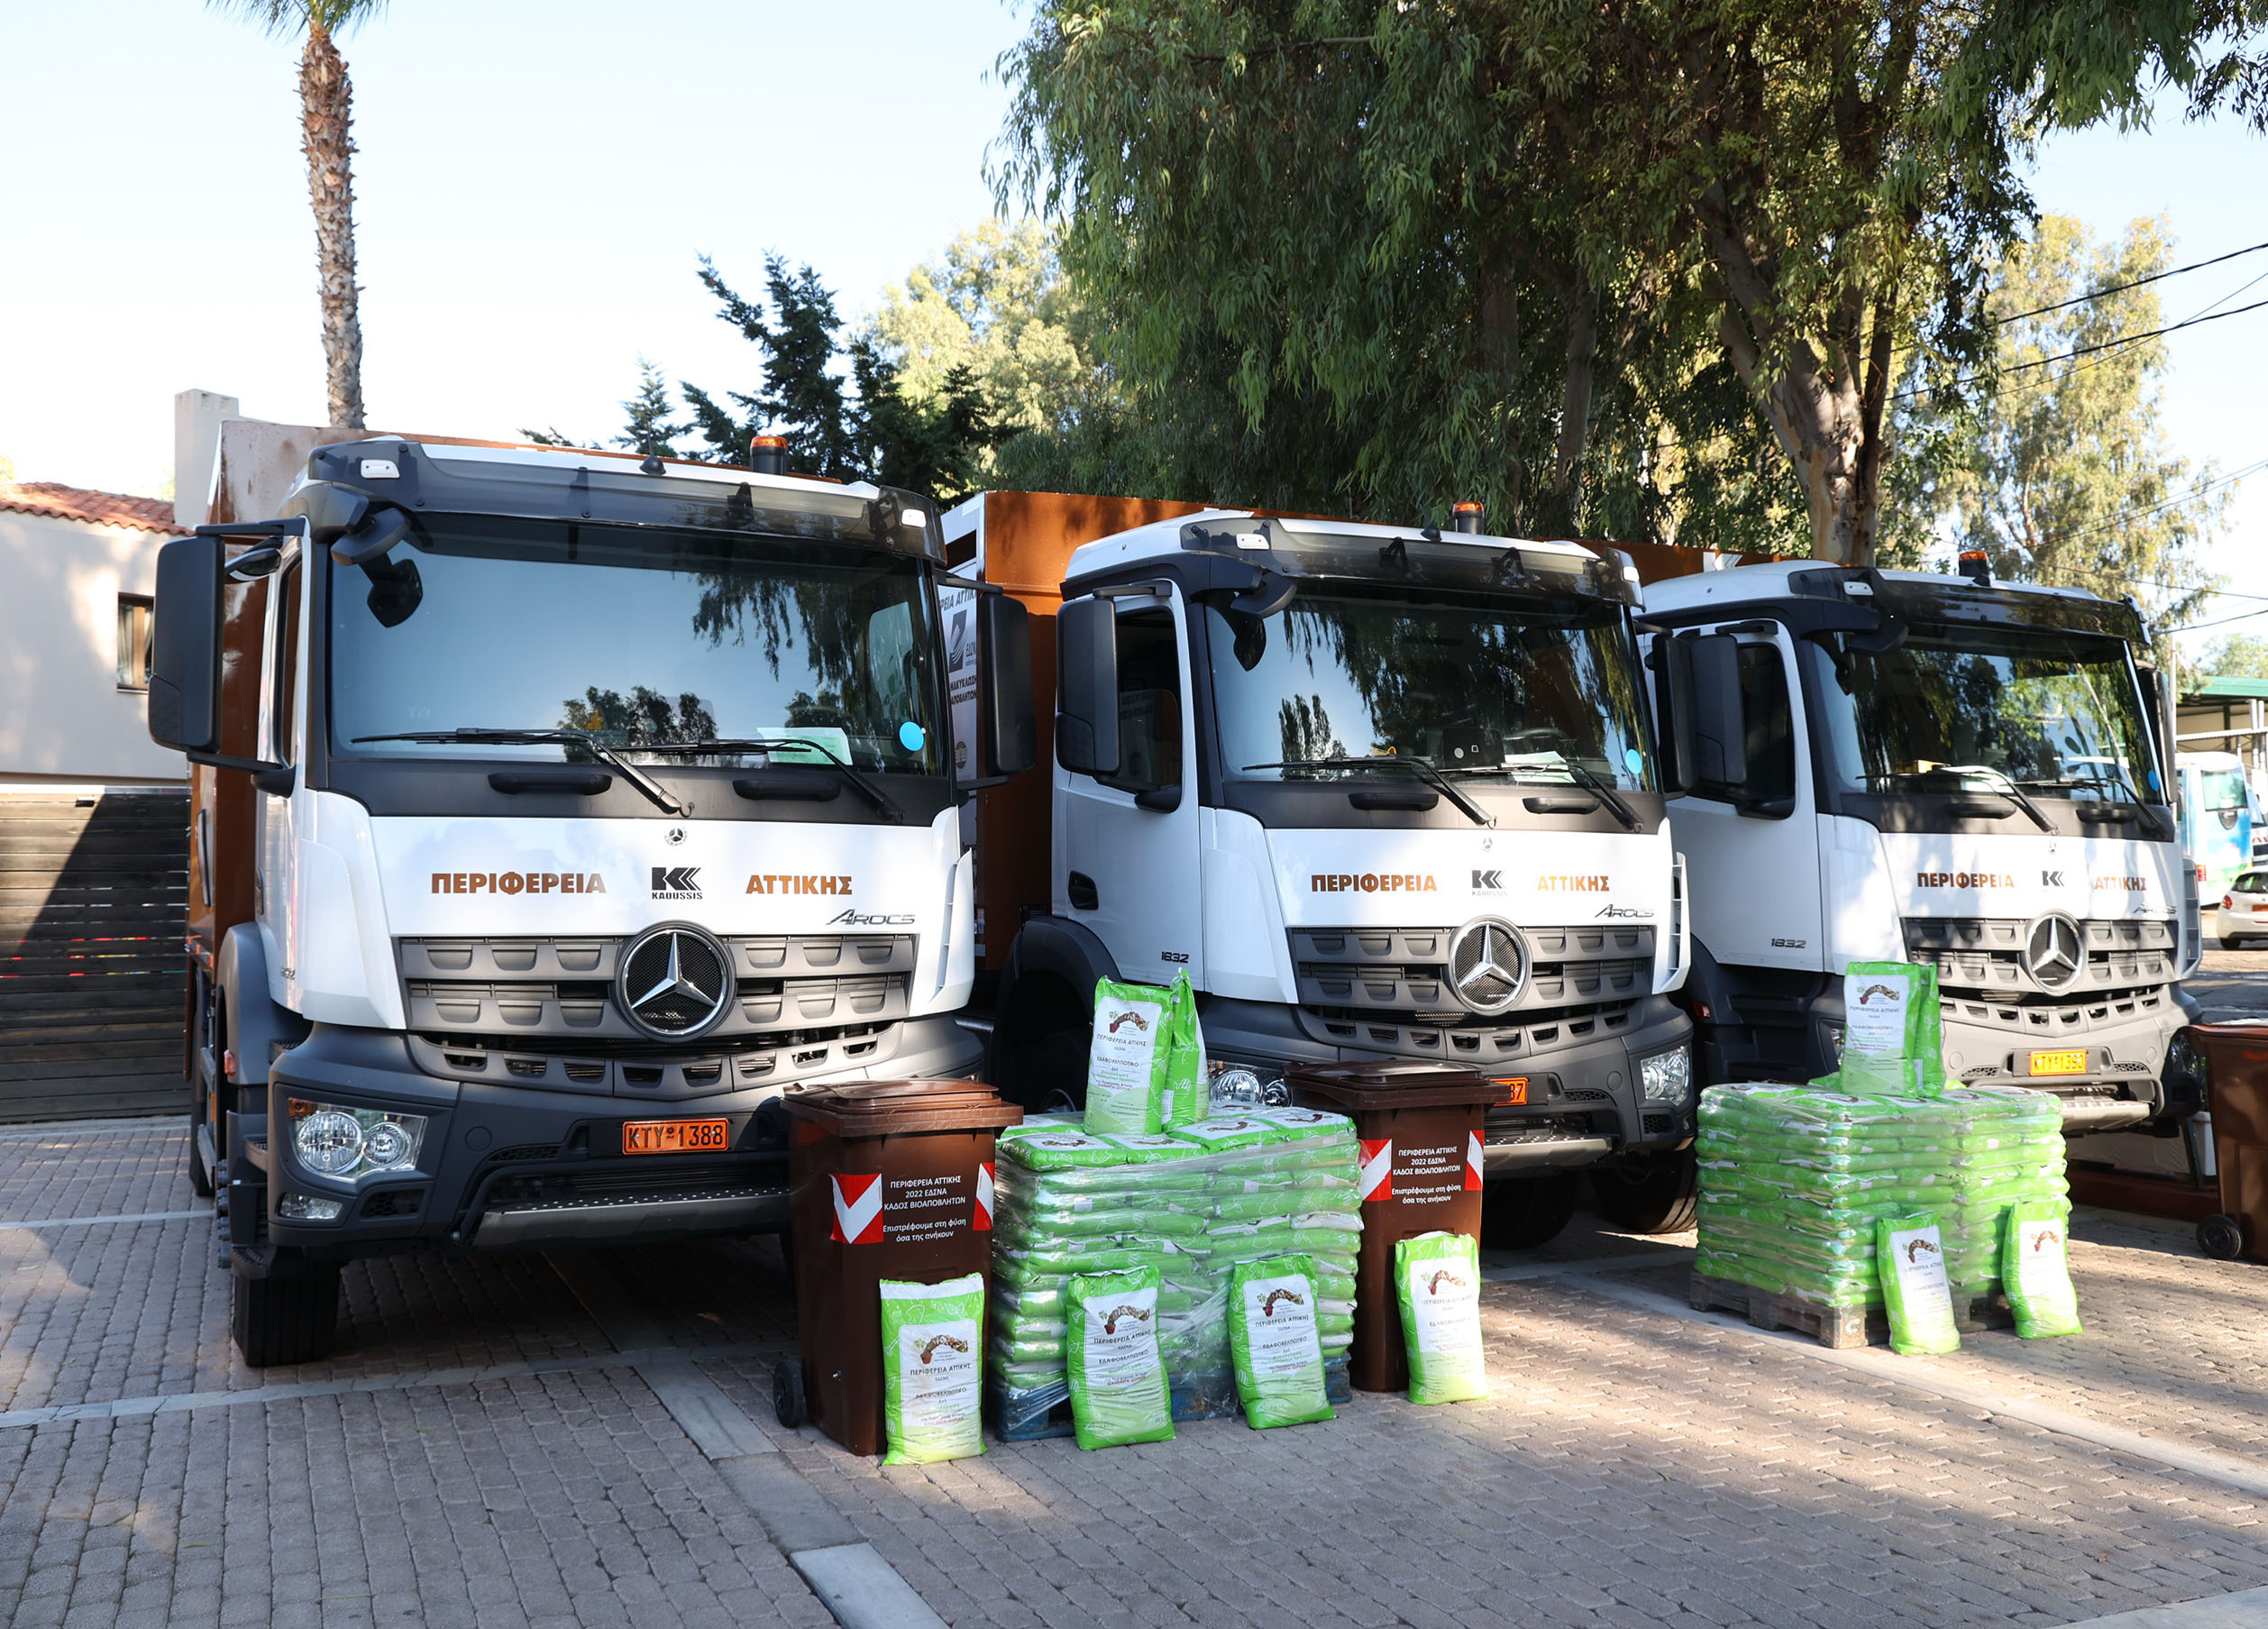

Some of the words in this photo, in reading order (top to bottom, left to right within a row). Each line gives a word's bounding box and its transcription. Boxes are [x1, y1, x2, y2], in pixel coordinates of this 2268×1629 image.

[431, 871, 607, 895] ΠΕΡΙΦΕΡΕΙΑ
[745, 874, 853, 895] ΑΤΤΙΚΗΣ
[1311, 873, 1438, 893] ΠΕΡΙΦΕΡΕΙΑ
[1537, 875, 1610, 892] ΑΤΤΙΚΗΣ
[1916, 872, 2015, 889] ΠΕΡΙΦΕΡΕΙΑ
[2094, 876, 2147, 891] ΑΤΤΙΚΗΣ
[652, 892, 703, 900] KAOUSSIS
[1771, 938, 1806, 949] 1832
[1161, 951, 1189, 964] 1832
[1096, 1033, 1127, 1045] ΠΕΡΙΦΕΡΕΙΑ
[1398, 1149, 1435, 1157] ΠΕΡΙΦΕΡΕΙΑ
[1435, 1146, 1458, 1154] ΑΤΤΙΚΗΣ
[1427, 1157, 1446, 1165] ΕΔΣΝΑ
[1414, 1165, 1460, 1175] ΒΙΟΑΠΟΒΛΗΤΩΝ
[890, 1178, 933, 1188] ΠΕΡΙΦΕΡΕΙΑ
[934, 1176, 962, 1185] ΑΤΤΙΚΗΣ
[905, 1190, 923, 1198] 2022
[924, 1187, 947, 1197] ΕΔΣΝΑ
[1391, 1186, 1434, 1195] Επιστρέφουμε
[1446, 1184, 1461, 1193] φύση
[883, 1202, 909, 1211] ΚΑΔΟΣ
[910, 1196, 966, 1209] ΒΙΟΑΠΟΒΛΗΤΩΝ
[1402, 1196, 1415, 1204] όσα
[1427, 1194, 1451, 1203] ανήκουν
[883, 1222, 933, 1233] Επιστρέφουμε
[947, 1218, 966, 1228] φύση
[896, 1234, 910, 1242] όσα
[911, 1234, 924, 1242] της
[925, 1231, 954, 1240] ανήκουν
[1255, 1317, 1287, 1328] ΠΕΡΙΦΕΡΕΙΑ
[1093, 1335, 1130, 1344] ΠΕΡΙΦΕΡΕΙΑ
[910, 1367, 947, 1376] ΠΕΡΙΦΕΡΕΙΑ
[948, 1362, 971, 1371] ΑΤΤΙΚΗΣ
